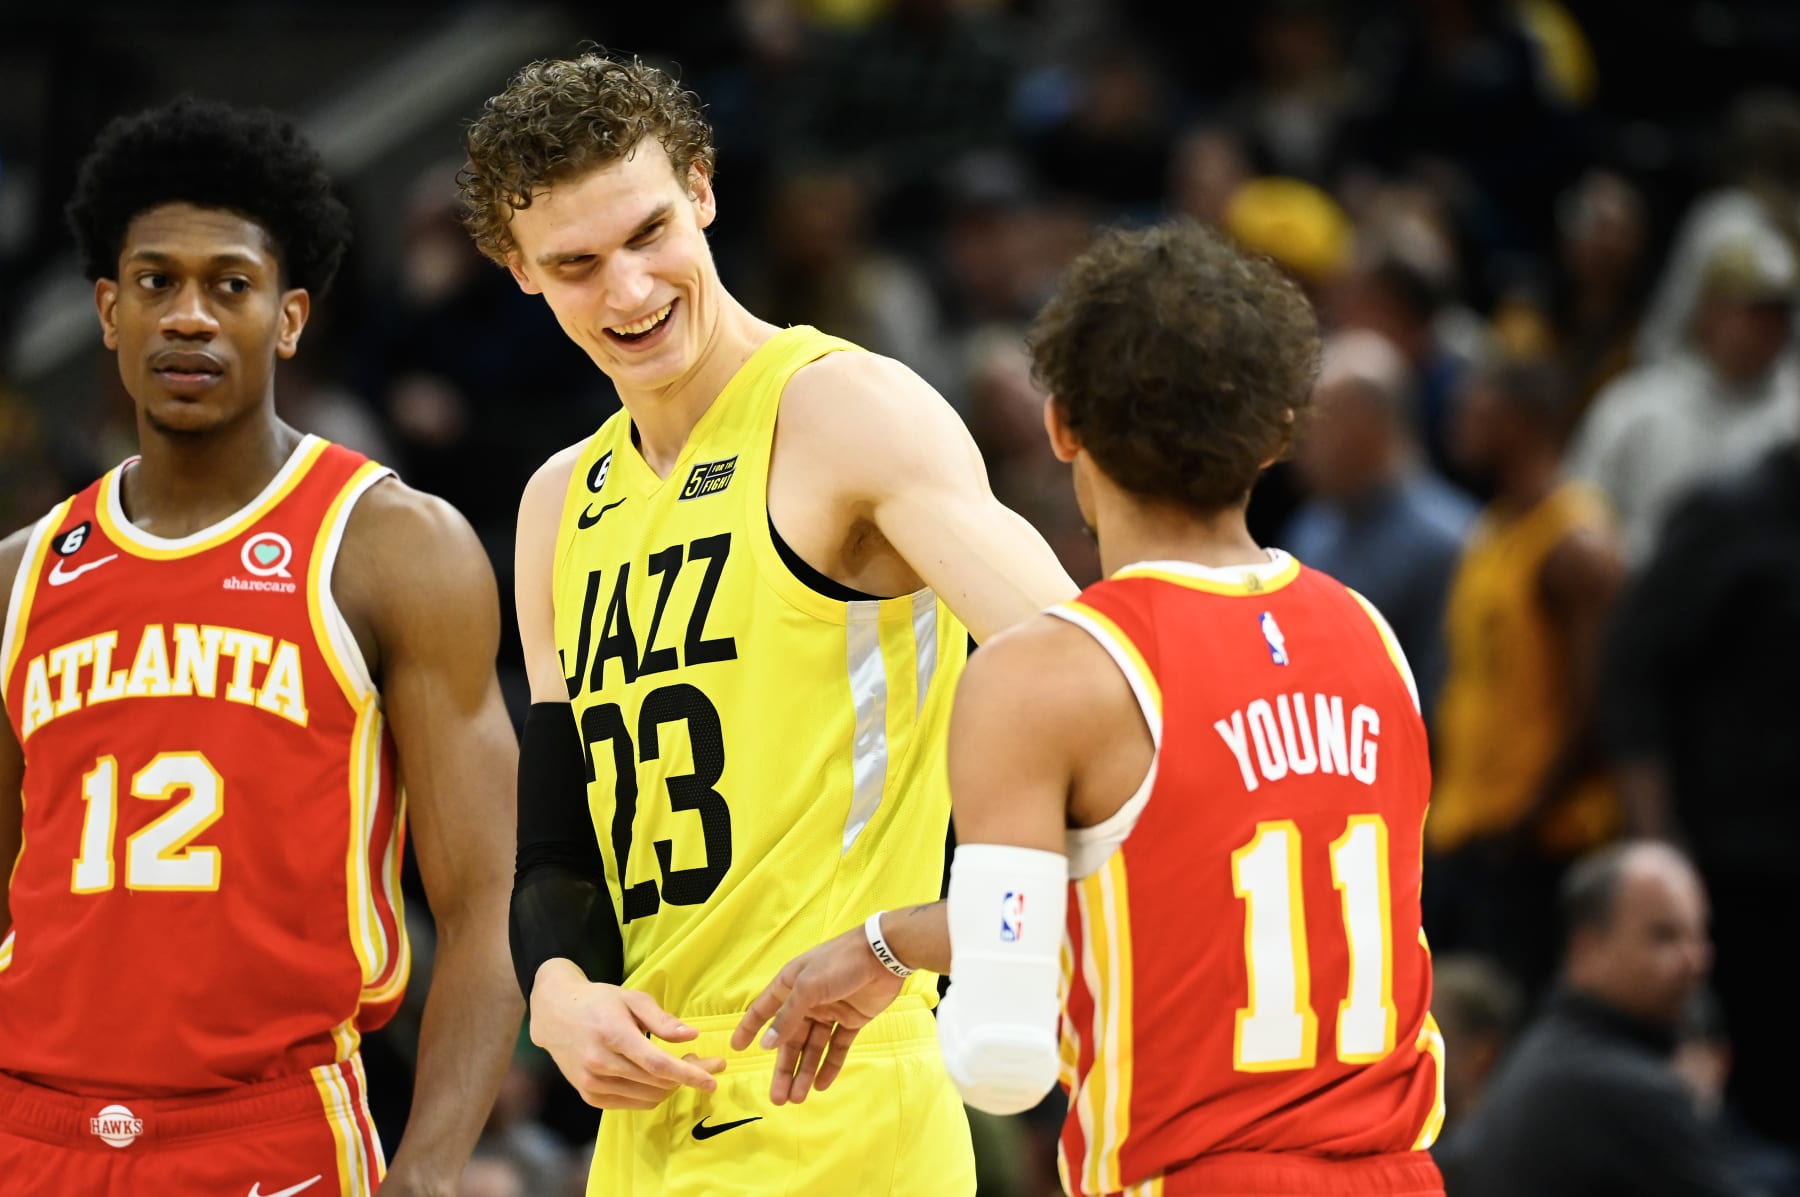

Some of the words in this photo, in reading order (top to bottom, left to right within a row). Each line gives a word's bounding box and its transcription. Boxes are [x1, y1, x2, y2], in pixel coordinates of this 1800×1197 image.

[594, 454, 612, 488] 6
[685, 467, 708, 497] 5
[701, 474, 733, 494] FIGHT
[711, 463, 725, 473] FOR
[60, 525, 86, 554] 6
[222, 576, 297, 594] sharecare
[558, 532, 738, 700] JAZZ
[22, 624, 309, 743] ATLANTA
[1214, 692, 1381, 792] YOUNG
[580, 683, 733, 925] 23
[71, 751, 224, 894] 12
[872, 940, 894, 966] LIVE
[1231, 814, 1398, 1074] 11
[91, 1119, 142, 1135] HAWKS
